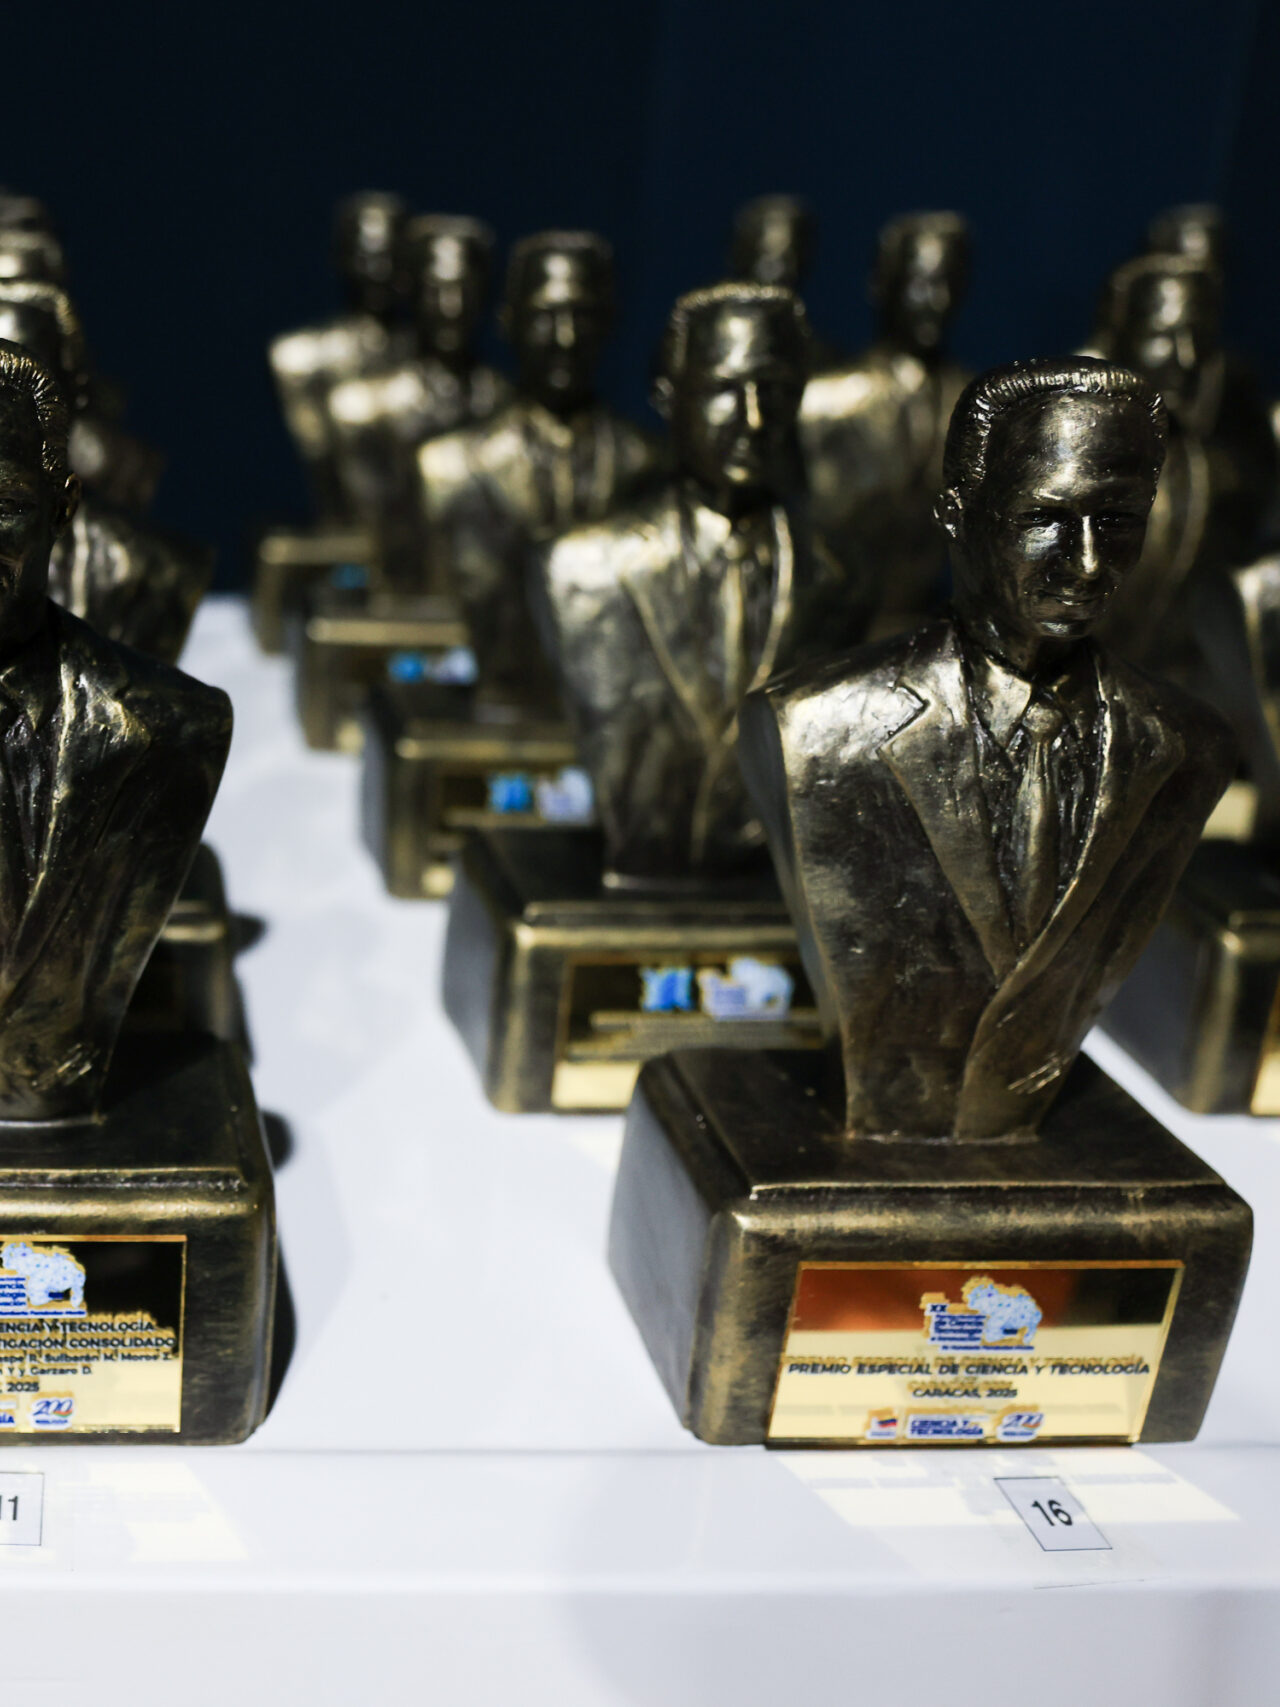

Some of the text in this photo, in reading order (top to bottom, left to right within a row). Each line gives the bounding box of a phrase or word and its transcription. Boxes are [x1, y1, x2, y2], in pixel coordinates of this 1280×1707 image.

[44, 1322, 55, 1333] Y
[59, 1321, 153, 1333] TECNOLOGÍA
[69, 1337, 177, 1348] CONSOLIDADO
[788, 1363, 1150, 1375] PREMIO ESPECIAL DE CIENCIA Y TECNOLOGÍA
[7, 1381, 40, 1393] 2025
[1031, 1498, 1074, 1527] 16
